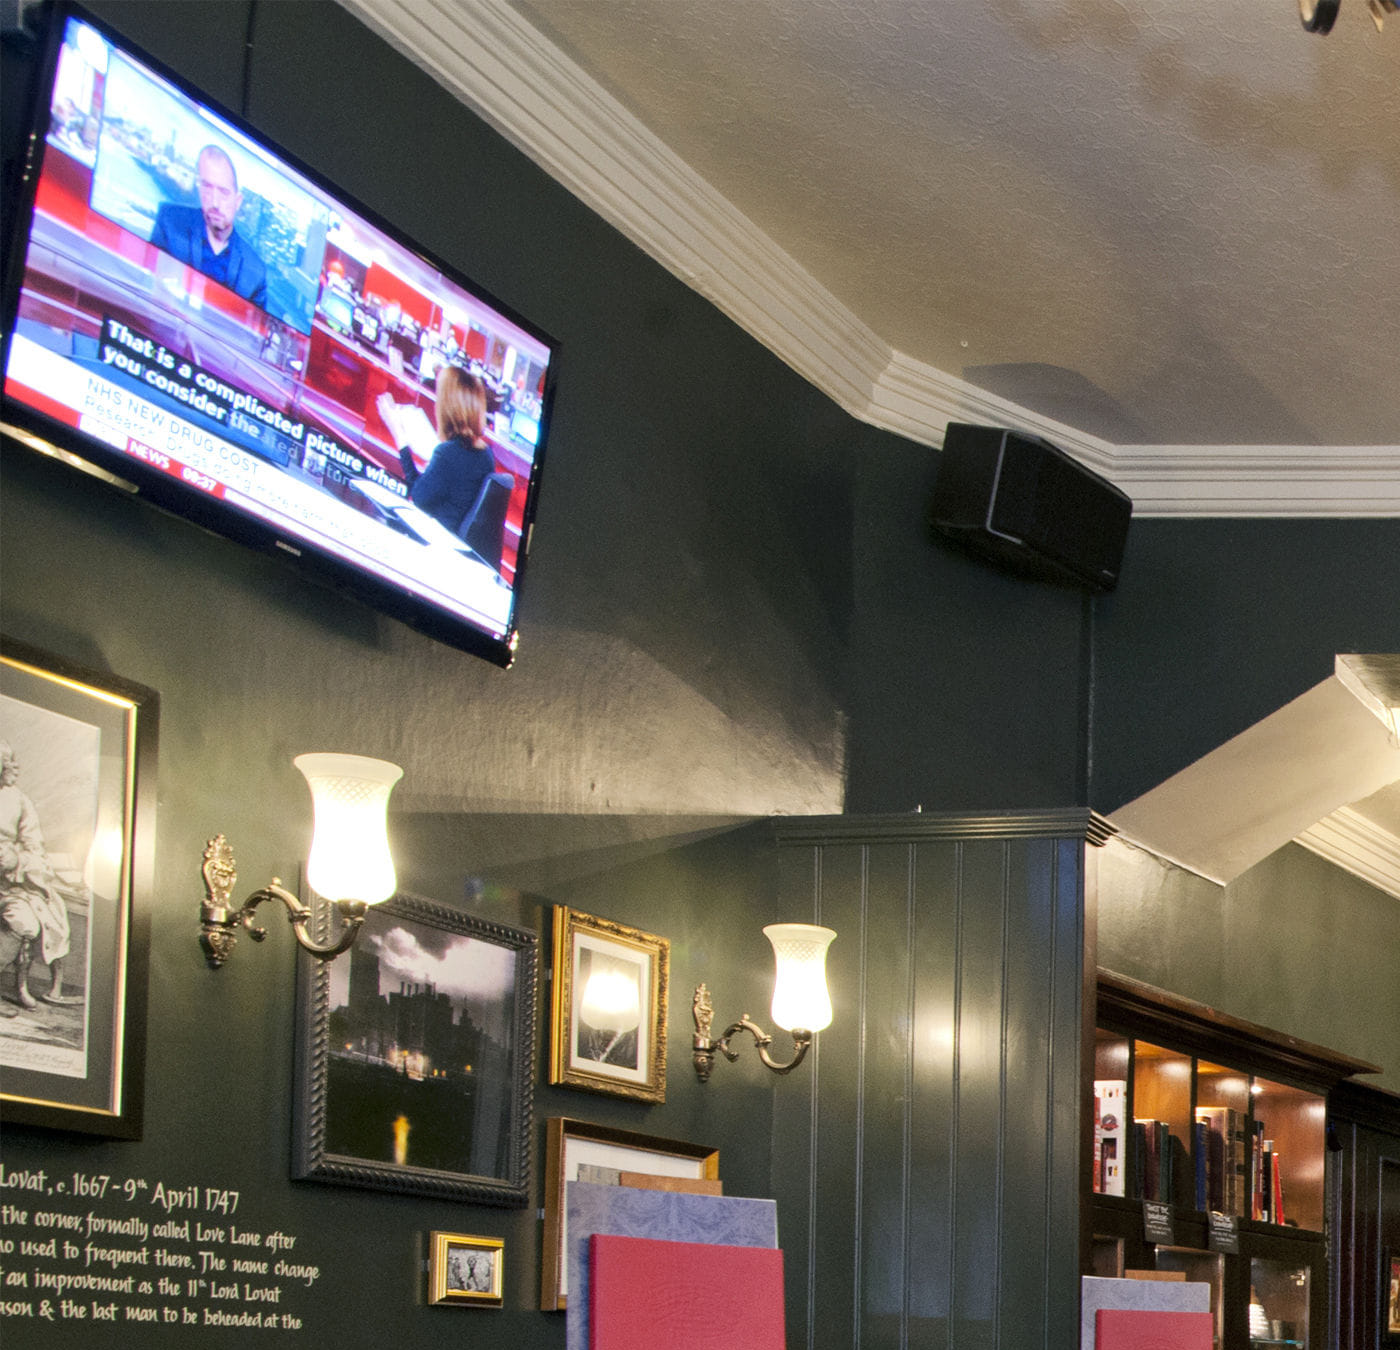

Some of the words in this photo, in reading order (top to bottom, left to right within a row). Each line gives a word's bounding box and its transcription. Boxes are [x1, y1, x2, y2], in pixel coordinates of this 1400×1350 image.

[104, 346, 140, 378] you
[146, 368, 226, 420] consider
[230, 410, 260, 439] the
[108, 319, 151, 357] That
[156, 350, 174, 368] is
[178, 363, 192, 378] a
[196, 372, 303, 439] complicated
[306, 430, 362, 472] picture
[365, 462, 407, 498] when
[88, 378, 122, 406] NHS
[128, 398, 165, 427] NEW
[170, 420, 214, 453] DRUG
[219, 446, 259, 475] COST
[128, 440, 170, 470] NEWS
[150, 1181, 199, 1214] April
[205, 1188, 240, 1215] 1747
[1, 1204, 28, 1226] the
[34, 1210, 84, 1234] corner,
[85, 1211, 149, 1242] formally
[152, 1220, 190, 1242] called
[196, 1222, 226, 1243] Love
[230, 1226, 261, 1246] Lane
[265, 1231, 297, 1254] after
[6, 1271, 28, 1288] an
[34, 1267, 136, 1296] improvement
[138, 1280, 153, 1295] as
[158, 1277, 181, 1297] the
[210, 1281, 240, 1300] Lord
[244, 1283, 282, 1303] Lovat
[20, 1238, 57, 1259] used
[63, 1240, 80, 1259] to
[84, 1241, 149, 1270] frequent
[153, 1248, 196, 1270] there.
[198, 1251, 228, 1275] The
[232, 1259, 269, 1275] name
[274, 1259, 321, 1287] change
[39, 1299, 56, 1321] &
[60, 1299, 87, 1319] the
[92, 1301, 120, 1321] last
[125, 1305, 159, 1322] man
[163, 1307, 178, 1323] to
[182, 1307, 198, 1324] be
[203, 1307, 262, 1328] beheaded
[264, 1314, 280, 1329] at
[281, 1313, 303, 1330] the
